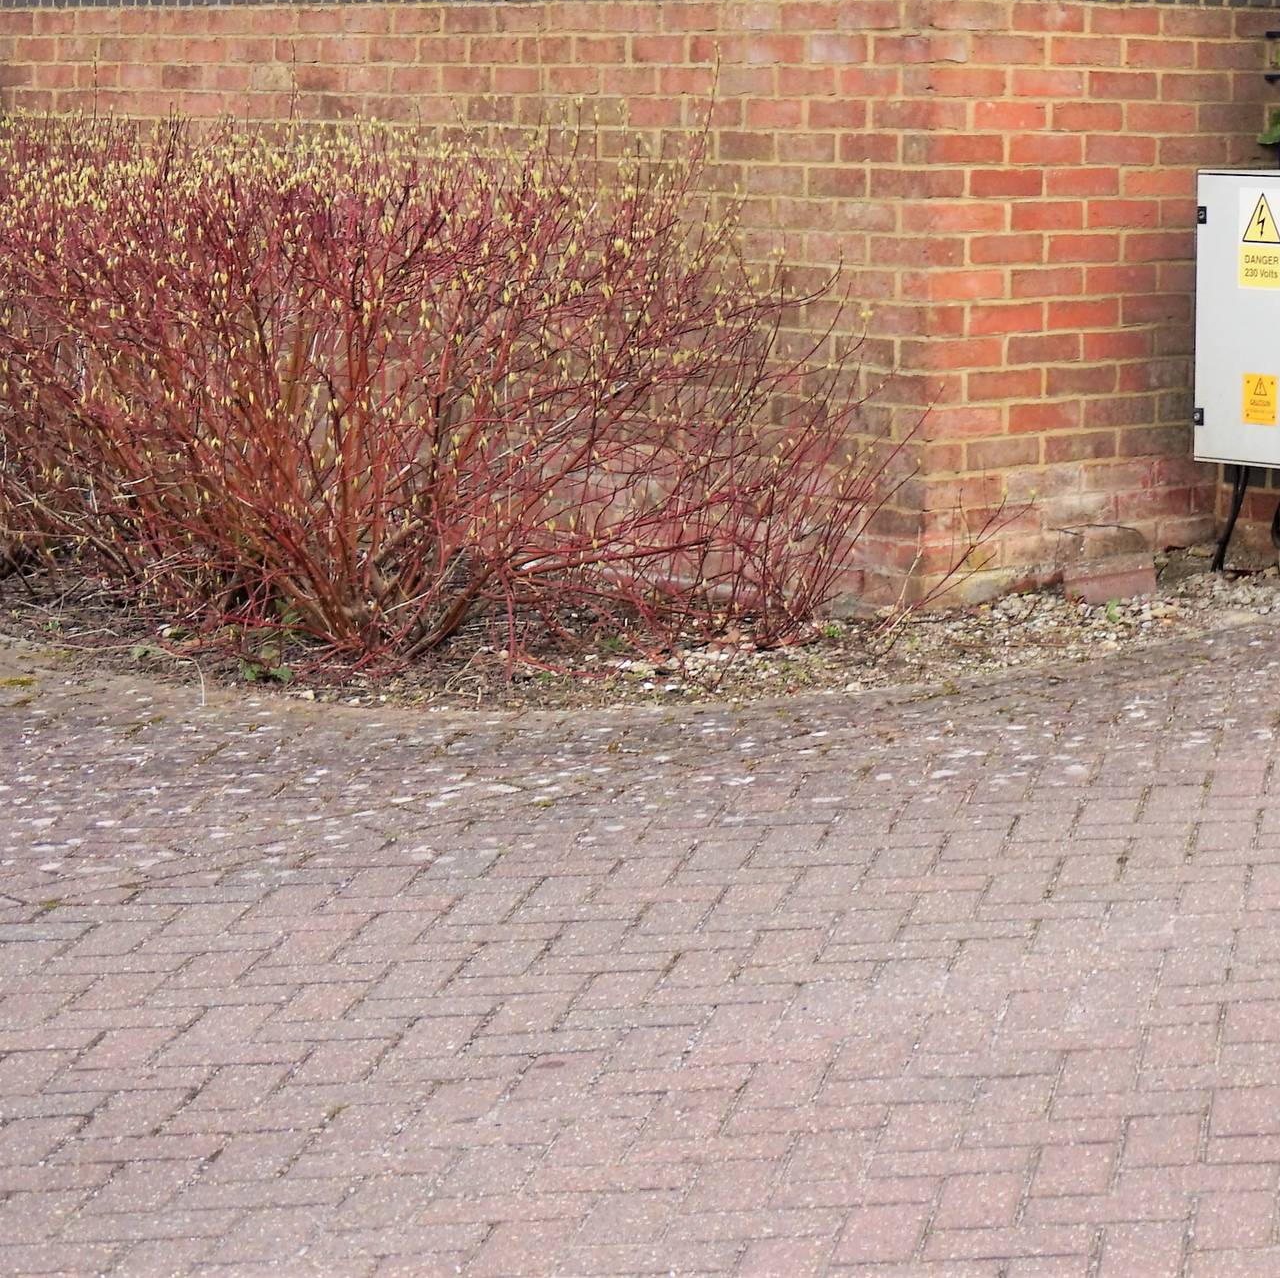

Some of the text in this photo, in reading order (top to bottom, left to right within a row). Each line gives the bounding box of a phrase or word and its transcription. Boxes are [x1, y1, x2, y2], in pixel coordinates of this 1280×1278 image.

[1244, 254, 1279, 265] DANGER
[1244, 267, 1279, 279] 230 Volts
